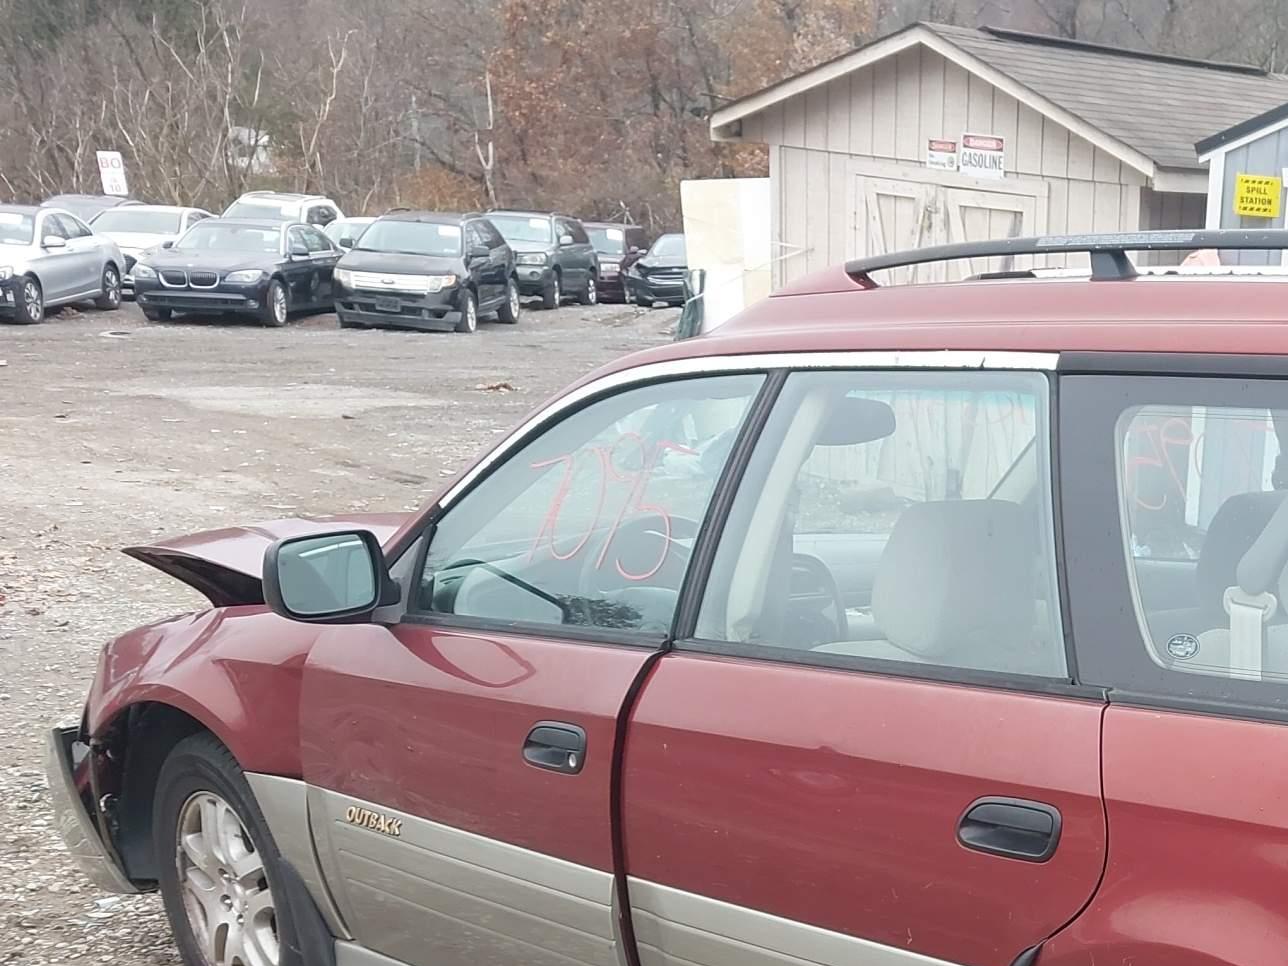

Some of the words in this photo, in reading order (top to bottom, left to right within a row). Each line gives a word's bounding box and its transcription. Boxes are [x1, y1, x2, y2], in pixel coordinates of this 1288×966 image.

[961, 151, 1004, 170] GASOLINE
[1246, 185, 1268, 195] SPILL
[1240, 195, 1272, 206] STATION
[528, 432, 702, 581] 7095
[346, 806, 402, 836] OUTBACK
